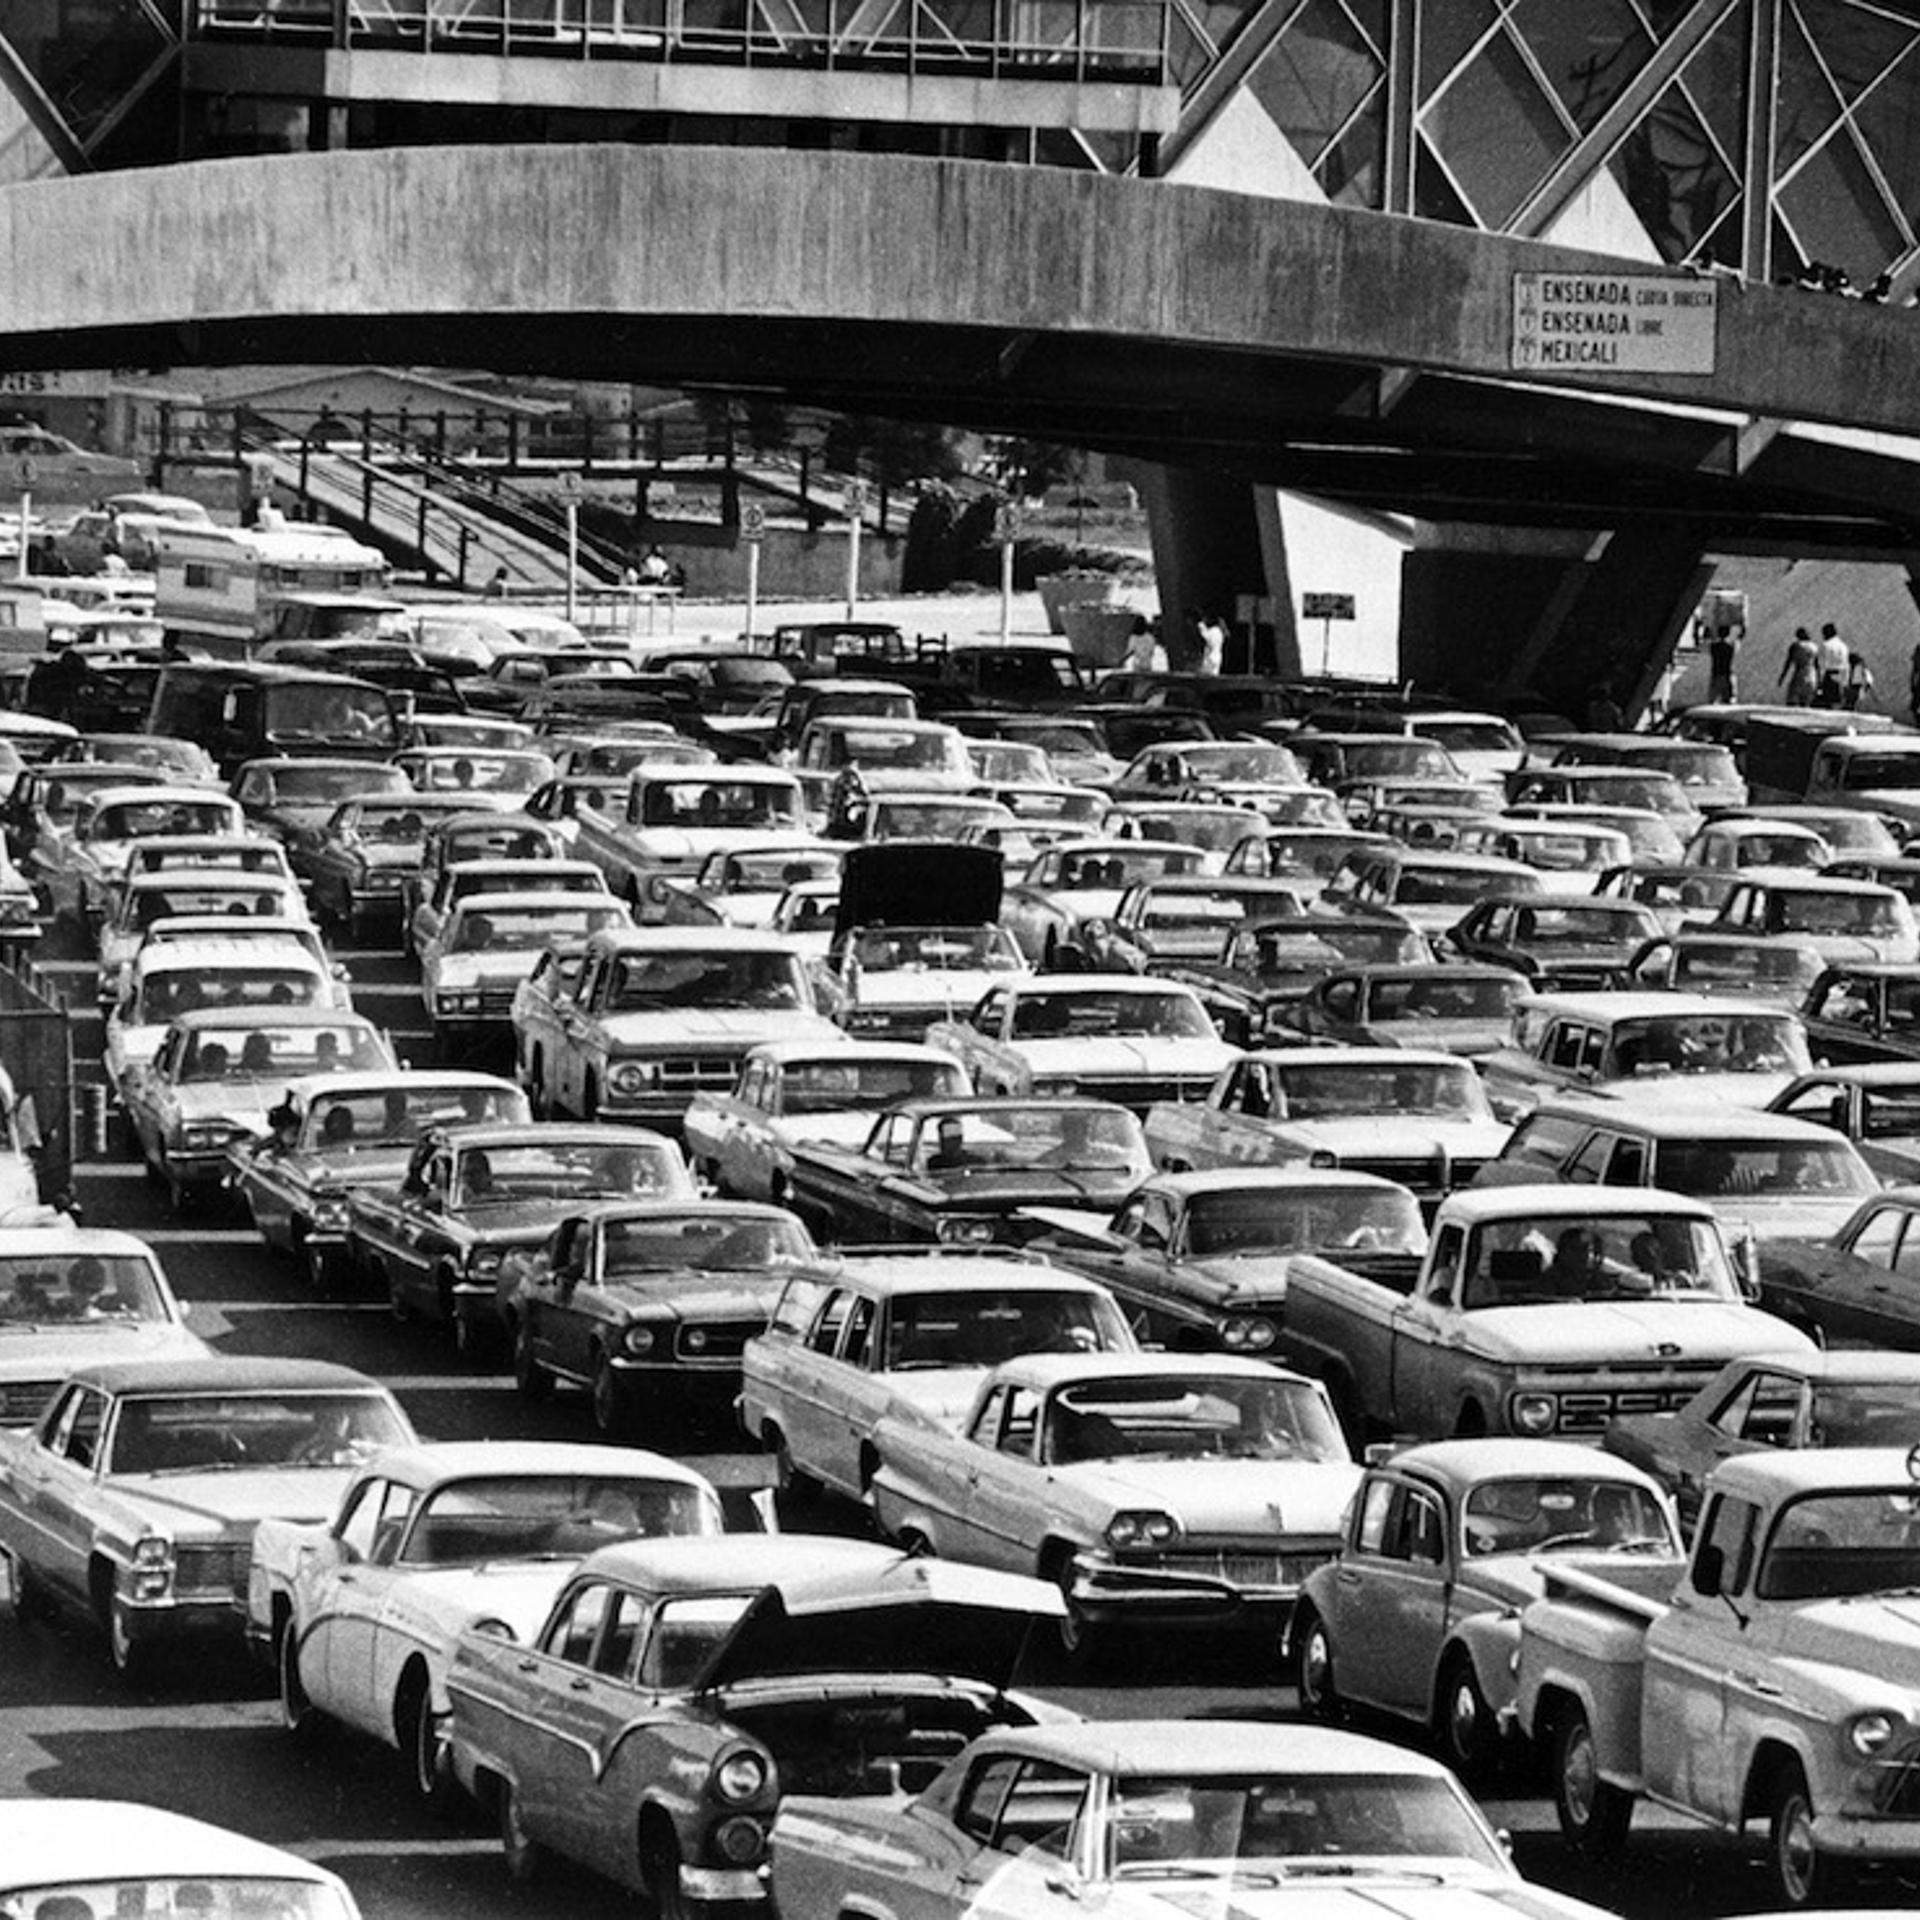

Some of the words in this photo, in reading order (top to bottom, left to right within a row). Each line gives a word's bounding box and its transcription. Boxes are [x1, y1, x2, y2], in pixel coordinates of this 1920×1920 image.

[1543, 281, 1631, 304] ENSENADA
[1542, 311, 1630, 334] ENSENADA
[1541, 341, 1617, 363] MEXICALI
